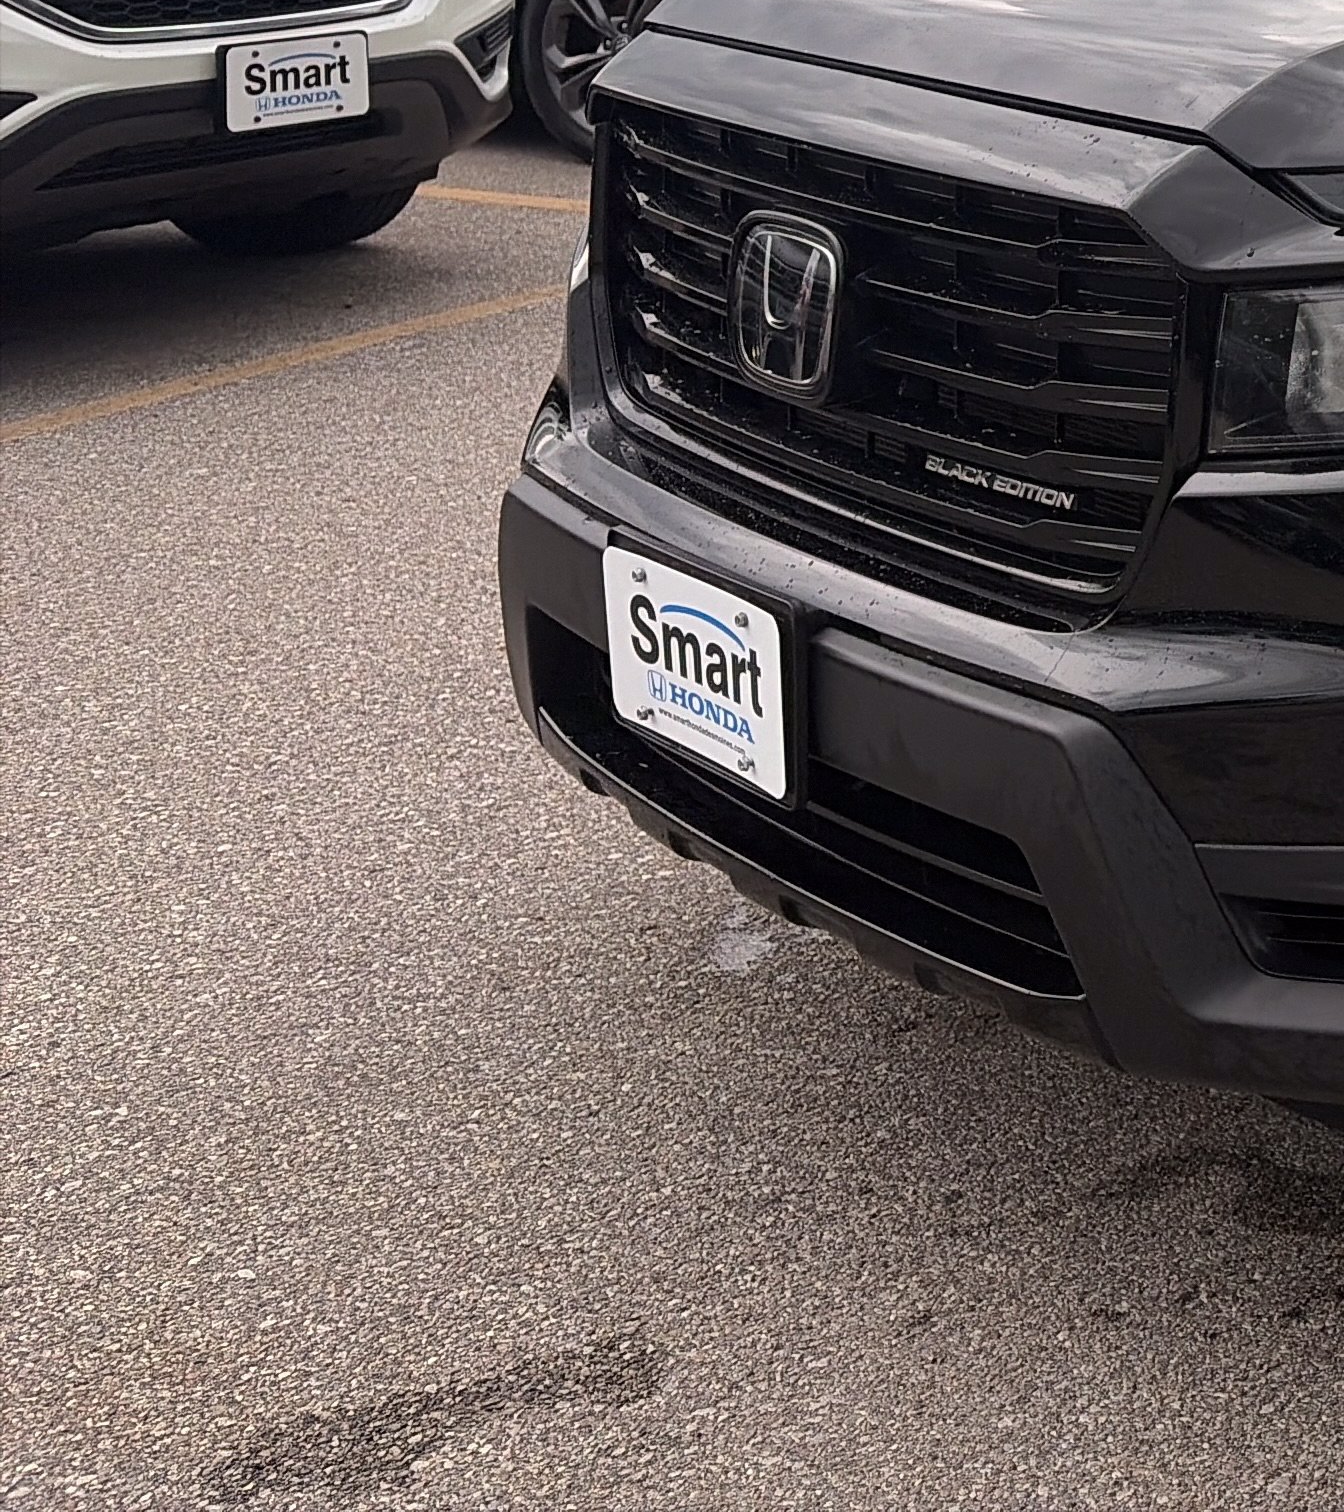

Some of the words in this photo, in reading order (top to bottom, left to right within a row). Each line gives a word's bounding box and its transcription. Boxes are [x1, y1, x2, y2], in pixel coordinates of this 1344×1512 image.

[244, 55, 351, 96] Smart
[273, 90, 342, 108] HONDA
[925, 454, 991, 488] BLACK
[992, 473, 1075, 510] EDITION
[630, 594, 763, 719] Smart
[669, 682, 755, 744] HONDA
